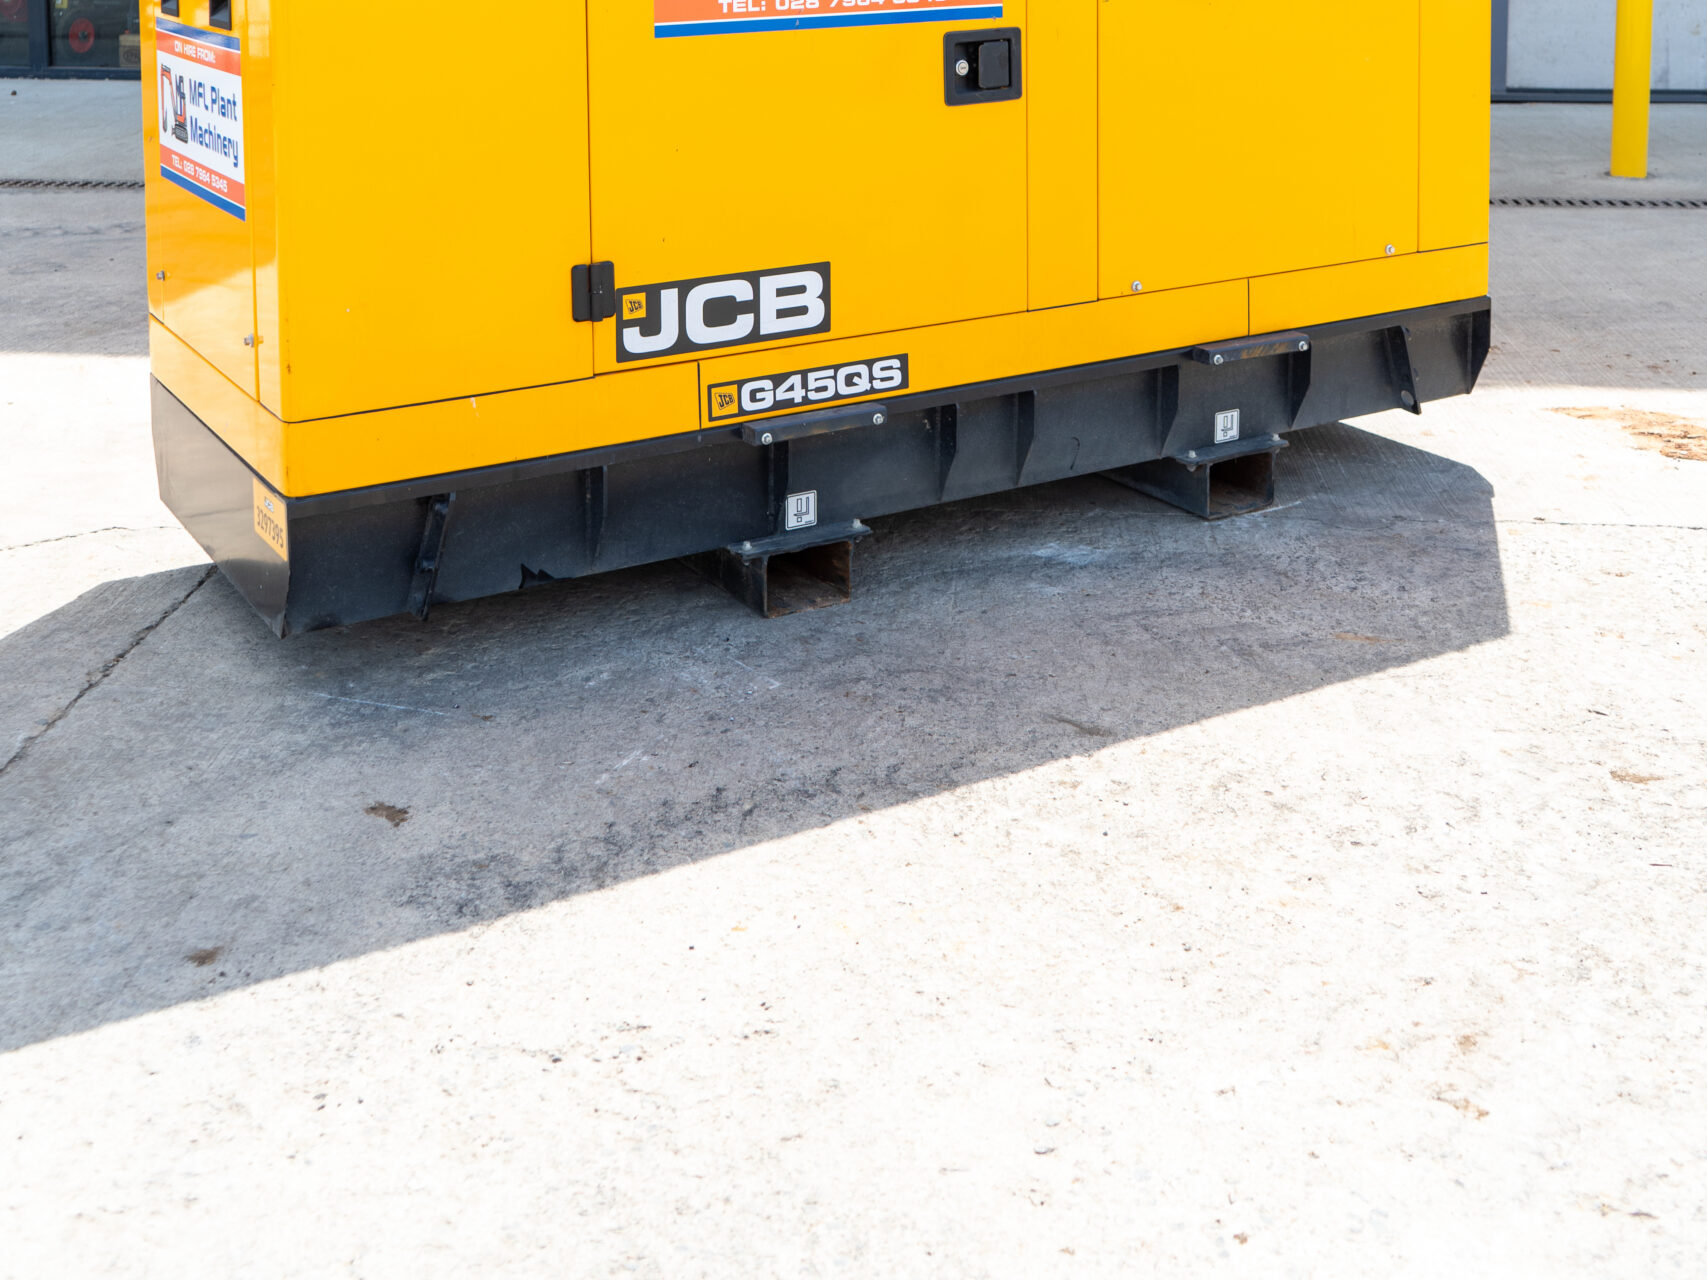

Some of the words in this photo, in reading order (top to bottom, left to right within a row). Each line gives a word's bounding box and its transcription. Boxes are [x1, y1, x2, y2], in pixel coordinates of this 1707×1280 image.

[174, 40, 183, 54] ON
[183, 43, 197, 59] HIRE
[189, 78, 209, 112] MFL
[210, 85, 238, 122] Plant
[190, 115, 239, 168] Machinery
[171, 154, 183, 170] TEL:
[622, 270, 826, 354] JCB
[628, 299, 643, 314] JCB
[717, 393, 735, 408] JCB
[741, 358, 902, 412] G45QS
